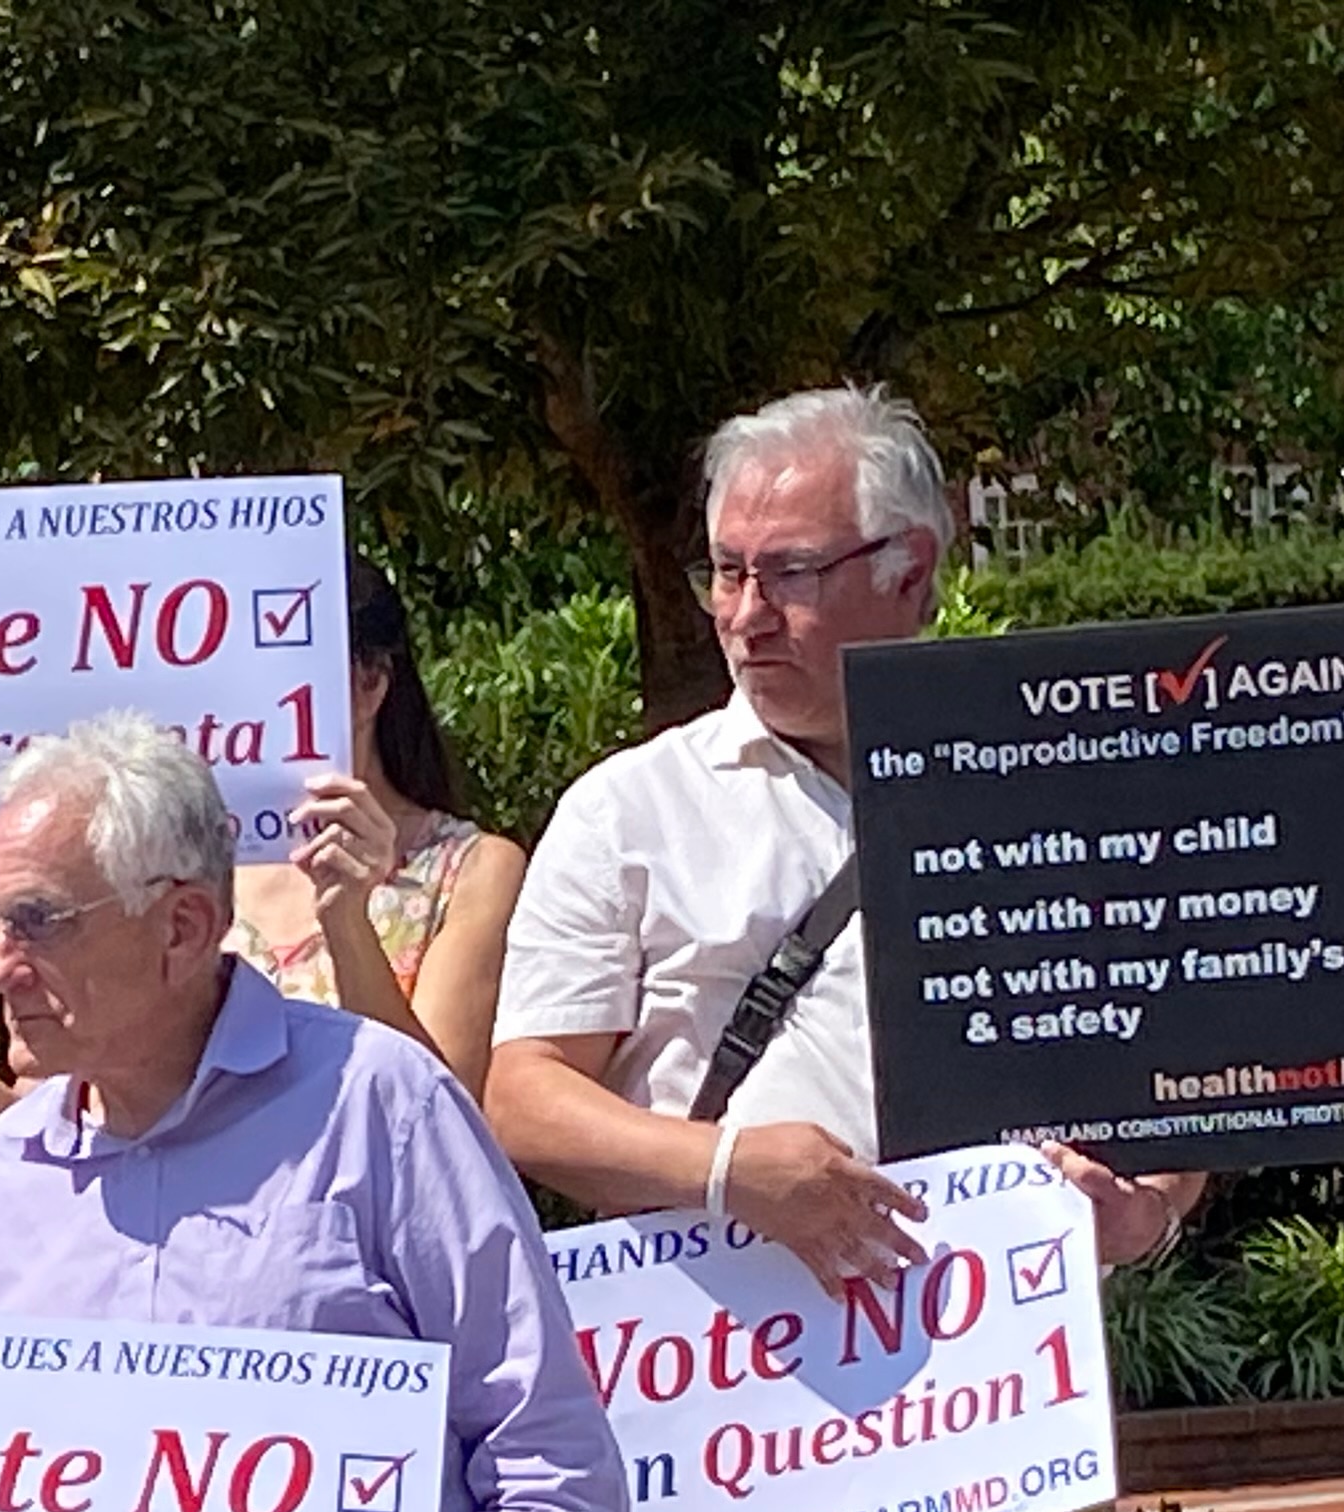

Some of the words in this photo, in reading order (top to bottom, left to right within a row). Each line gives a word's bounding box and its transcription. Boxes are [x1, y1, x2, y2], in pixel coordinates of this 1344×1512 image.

[5, 508, 27, 540] A
[37, 498, 220, 539] NUESTROS
[228, 493, 328, 535] HIJOS
[71, 578, 230, 673] NO
[276, 683, 331, 762] 1
[1019, 673, 1136, 716] VOTE
[868, 748, 926, 778] the
[934, 727, 1181, 777] “Reproductive
[913, 838, 984, 874] not
[993, 831, 1088, 867] with
[1098, 830, 1162, 865] my
[1173, 814, 1278, 853] child
[918, 905, 990, 940] not
[998, 897, 1093, 934] with
[1104, 897, 1168, 931] my
[1177, 884, 1319, 921] money
[922, 966, 994, 1001] not
[1003, 958, 1098, 995] with
[1108, 958, 1171, 992] my
[966, 1010, 999, 1044] &
[1011, 1001, 1144, 1040] safety
[1000, 1121, 1114, 1146] MARYLAND
[1117, 1106, 1289, 1140] CONSTITUTIONAL
[549, 1221, 710, 1283] HANDS
[575, 1308, 804, 1411] Vote
[836, 1248, 988, 1367] NO
[75, 1340, 102, 1373] A
[112, 1341, 317, 1386] NUESTROS
[322, 1353, 434, 1399] HIJOS
[703, 1372, 1026, 1500] Question
[1034, 1324, 1089, 1408] 1
